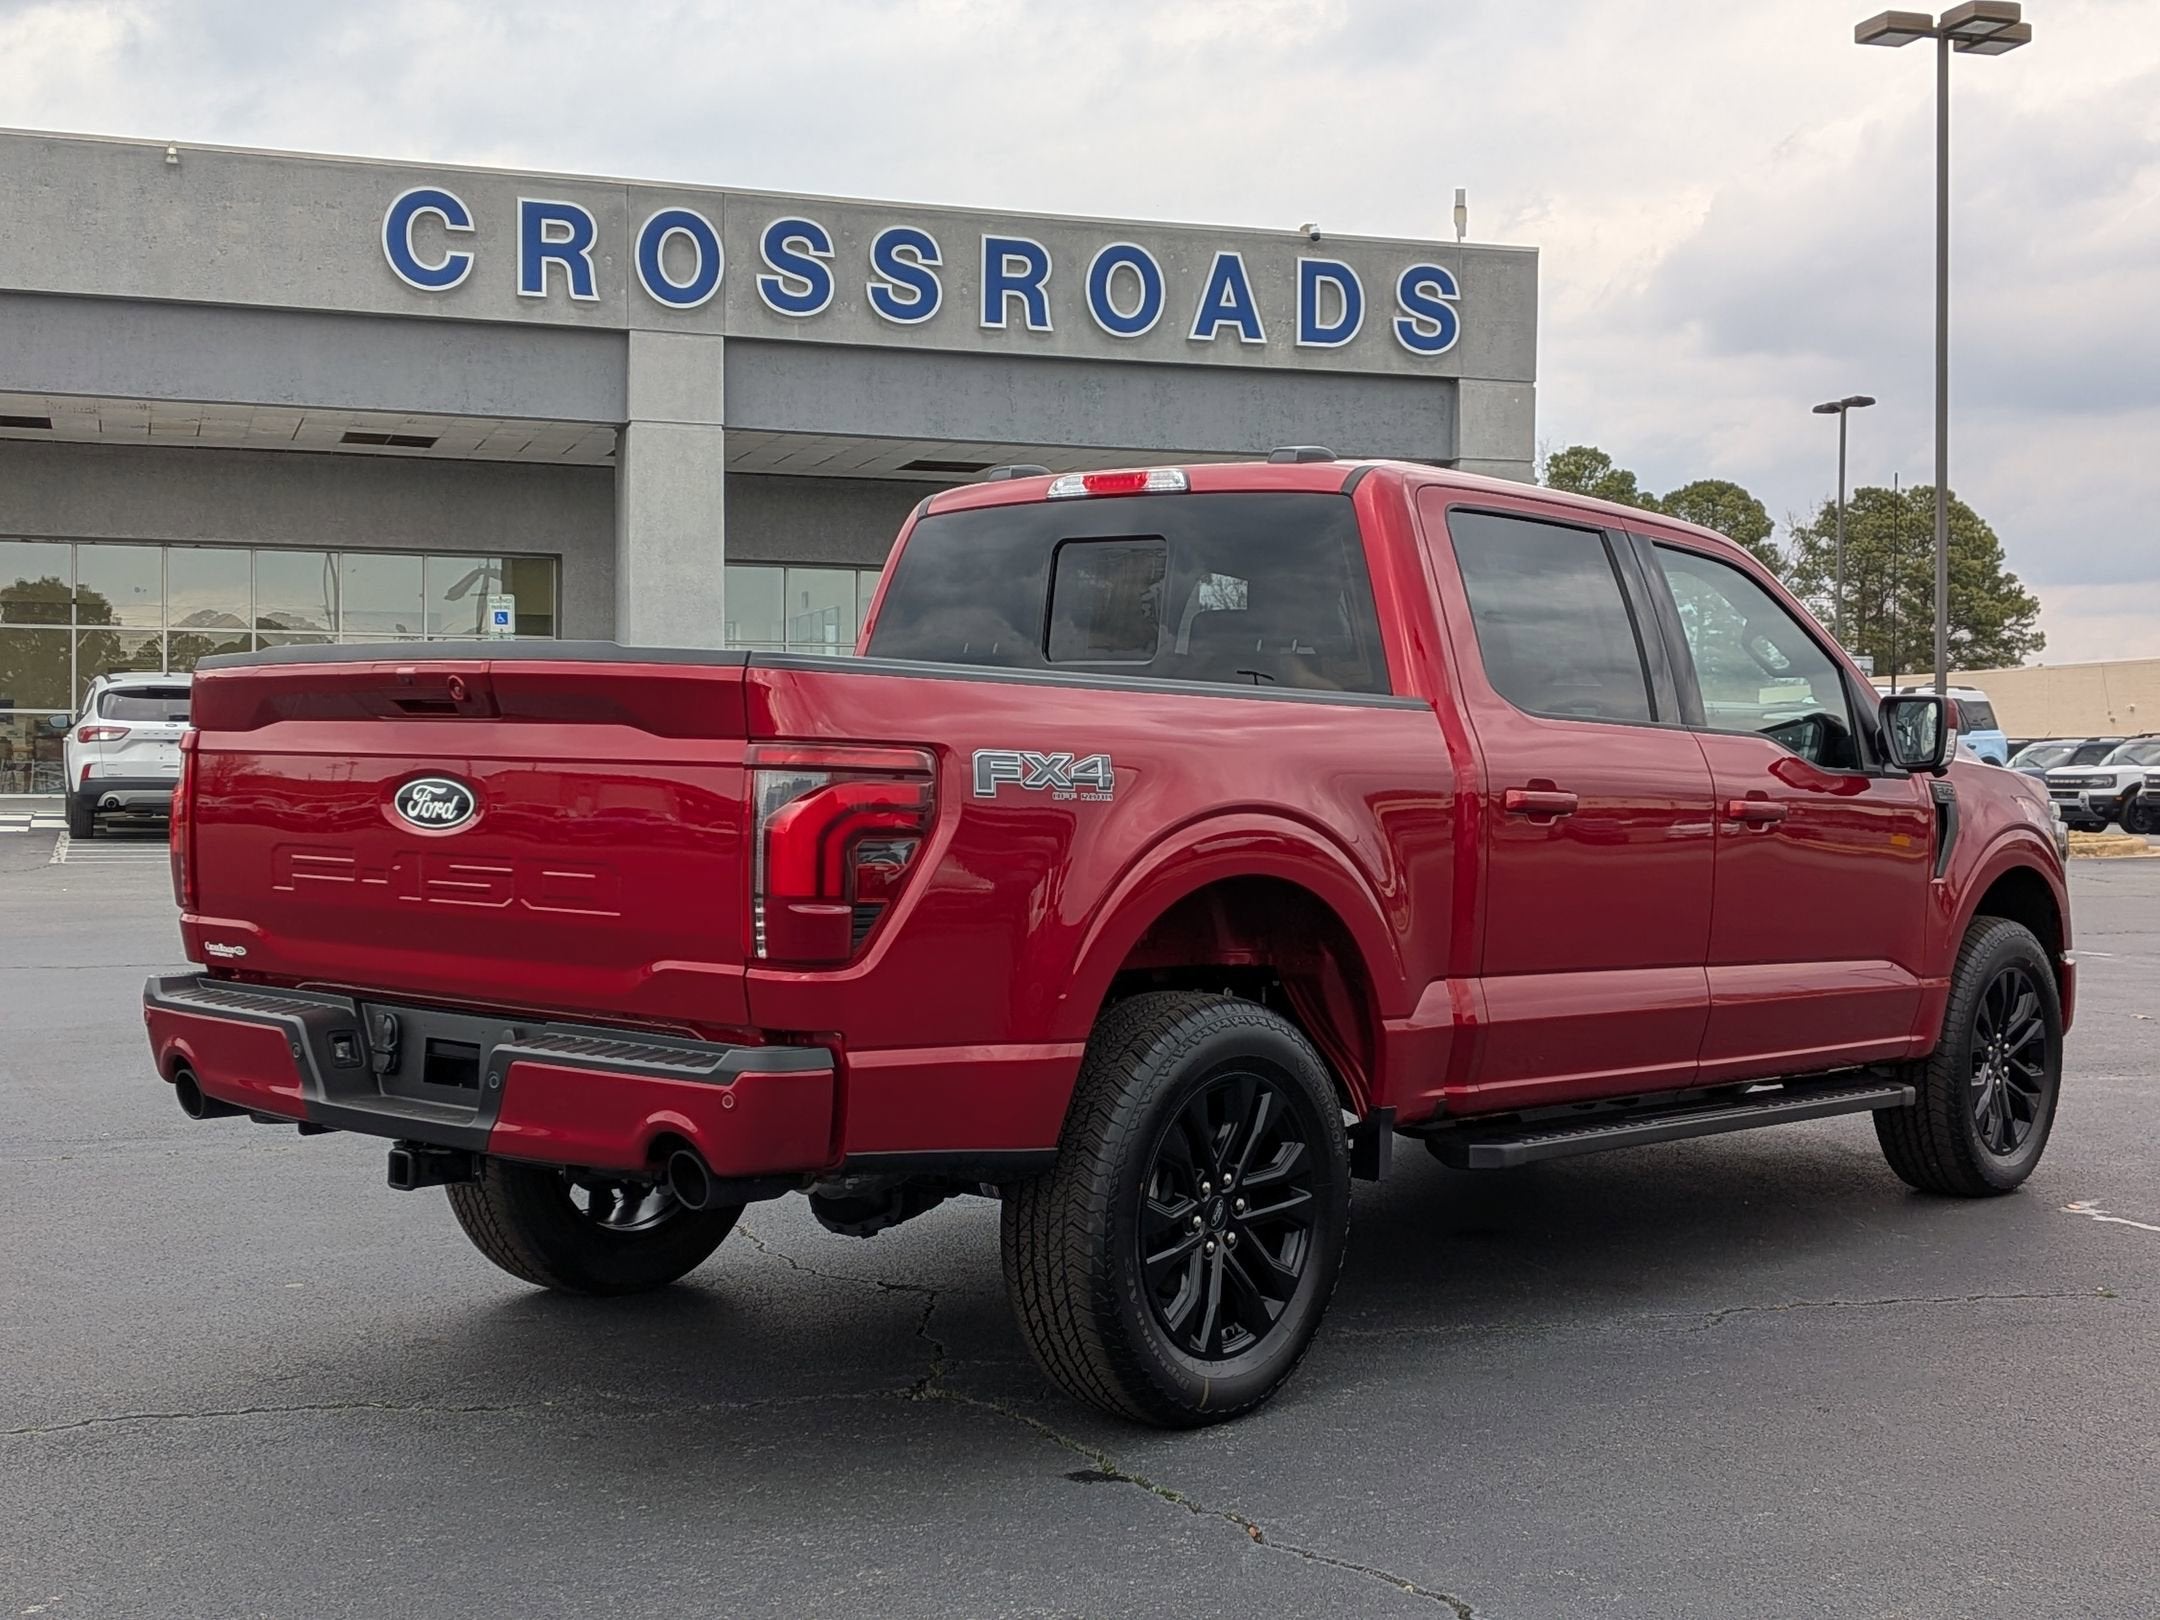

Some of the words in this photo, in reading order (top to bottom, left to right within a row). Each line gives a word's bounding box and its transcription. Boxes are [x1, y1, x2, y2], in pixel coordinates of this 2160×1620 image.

[381, 186, 1461, 356] CROSSROADS
[406, 784, 459, 820] Ford
[972, 749, 1115, 798] FX4
[271, 842, 623, 917] F-150
